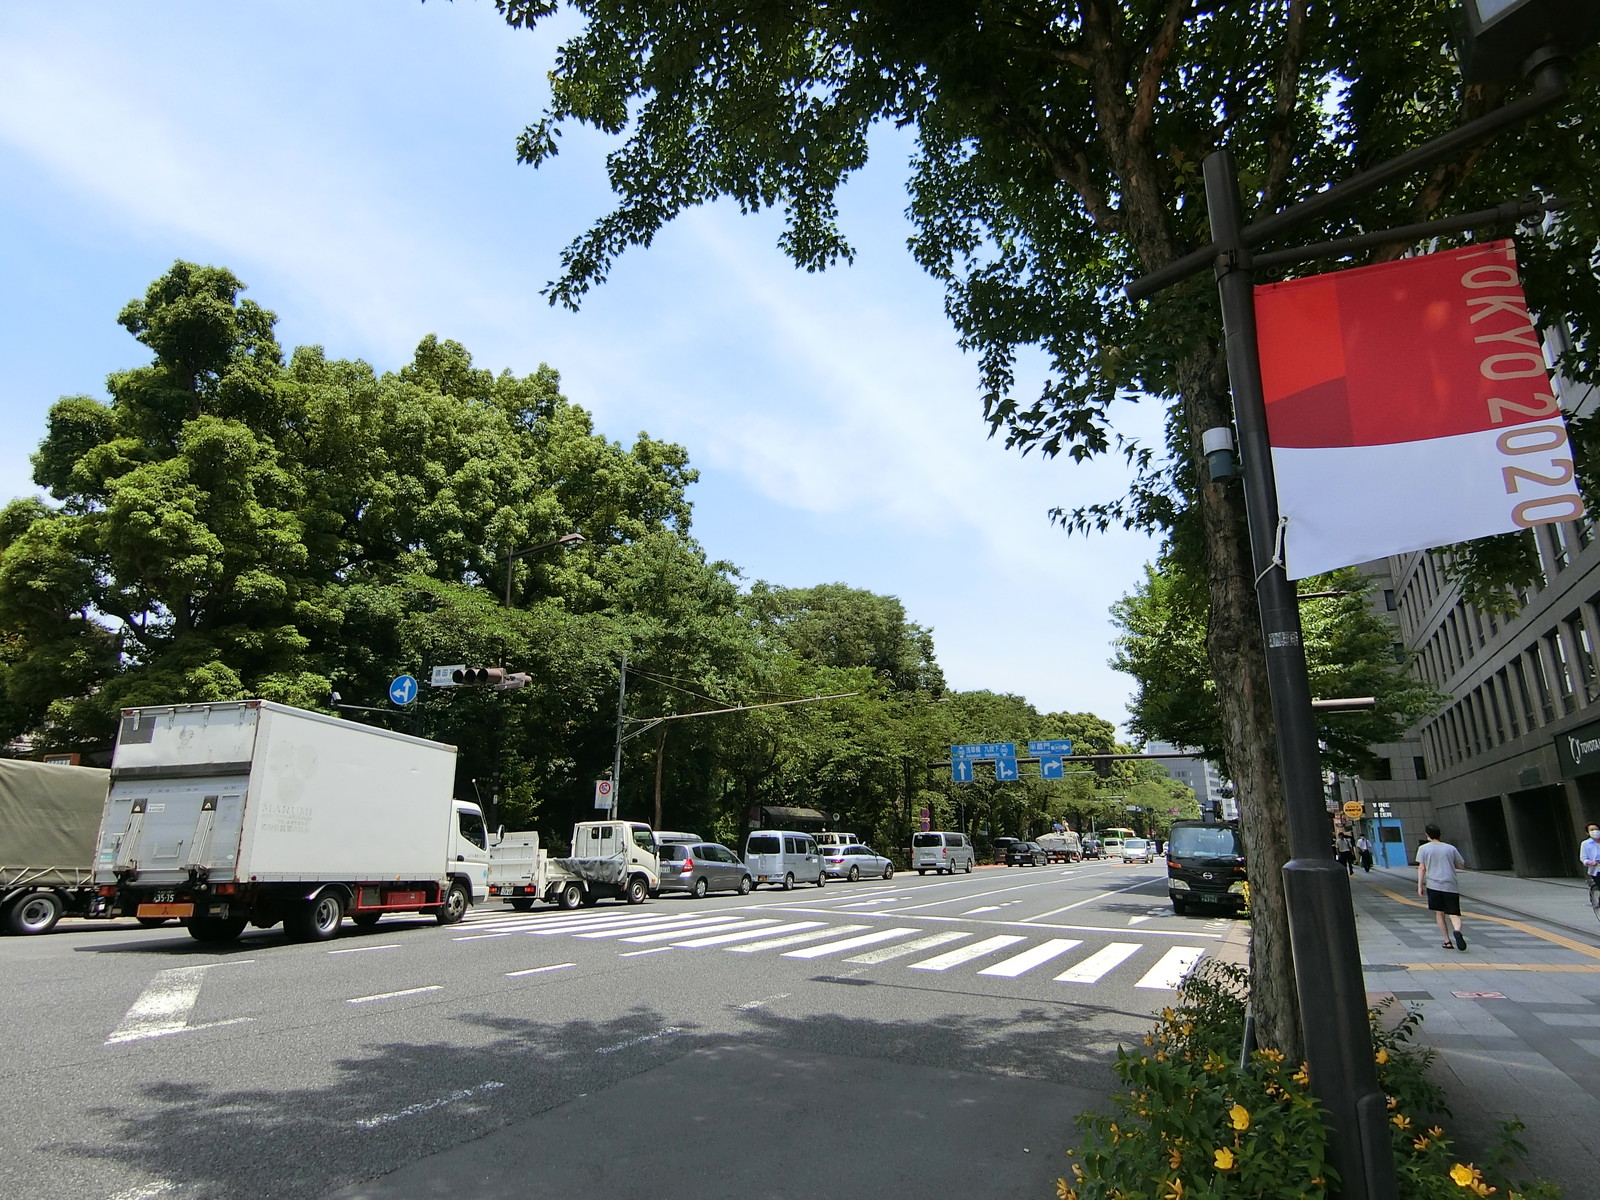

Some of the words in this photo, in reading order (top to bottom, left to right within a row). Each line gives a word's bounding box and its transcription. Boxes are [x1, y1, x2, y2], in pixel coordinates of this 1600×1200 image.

[1456, 238, 1546, 381] TOKYO
[1487, 393, 1585, 529] 2020
[1580, 739, 1599, 754] TOYOTA
[262, 804, 313, 816] MARUMI
